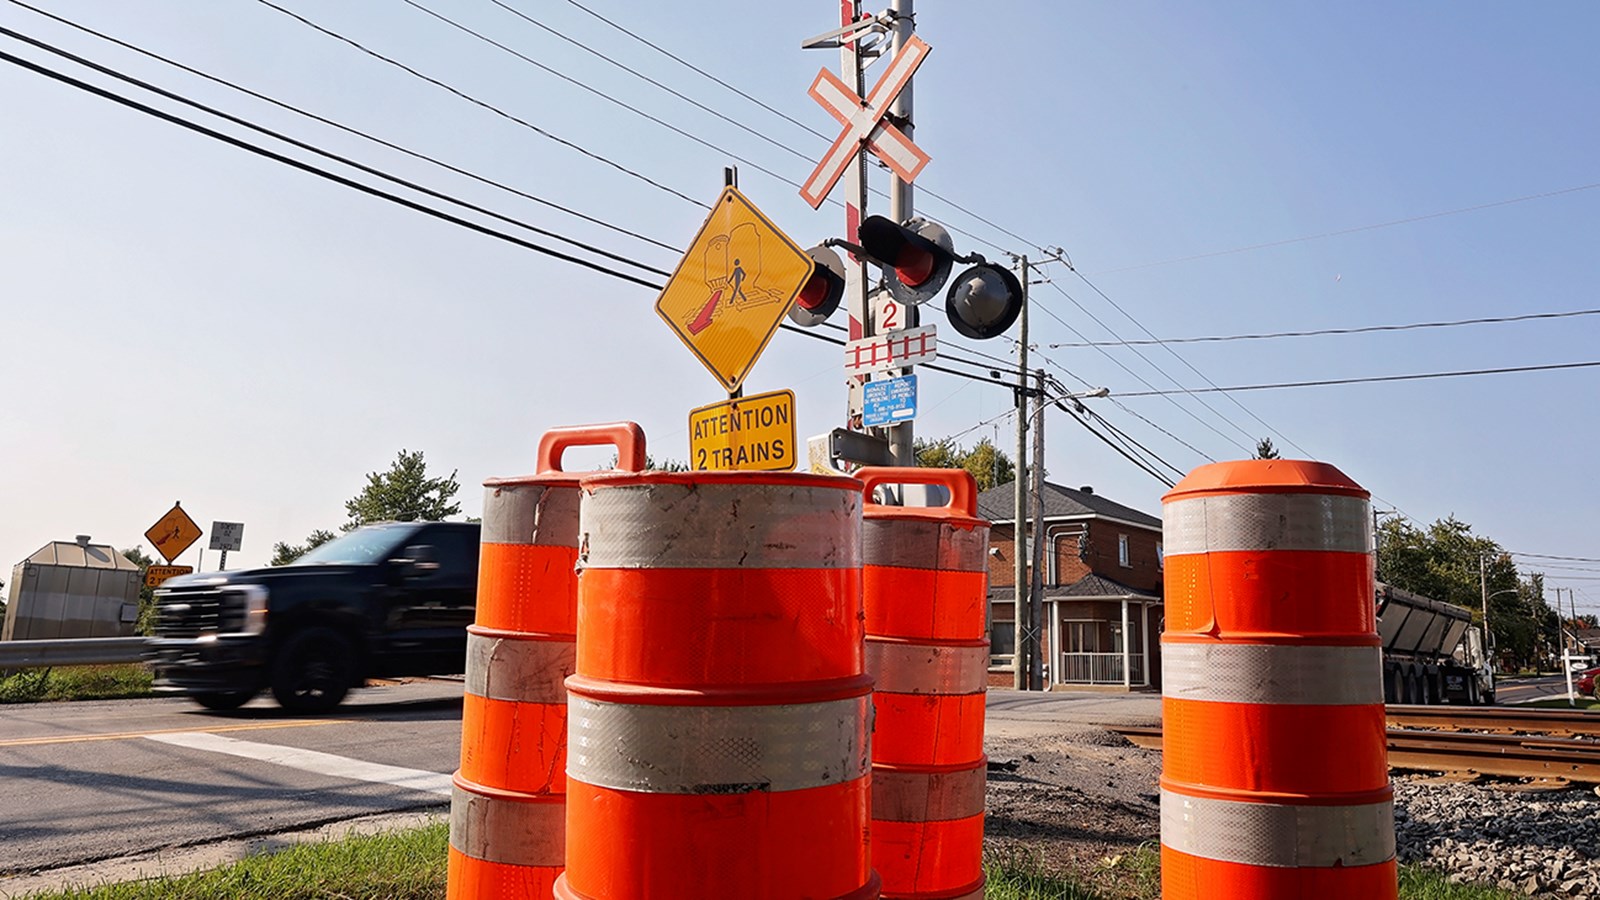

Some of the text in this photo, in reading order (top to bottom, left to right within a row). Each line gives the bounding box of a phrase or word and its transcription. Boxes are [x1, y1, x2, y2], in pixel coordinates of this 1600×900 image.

[883, 303, 897, 328] 2
[693, 403, 788, 440] ATTENTION
[697, 439, 785, 470] 2 TRAINS
